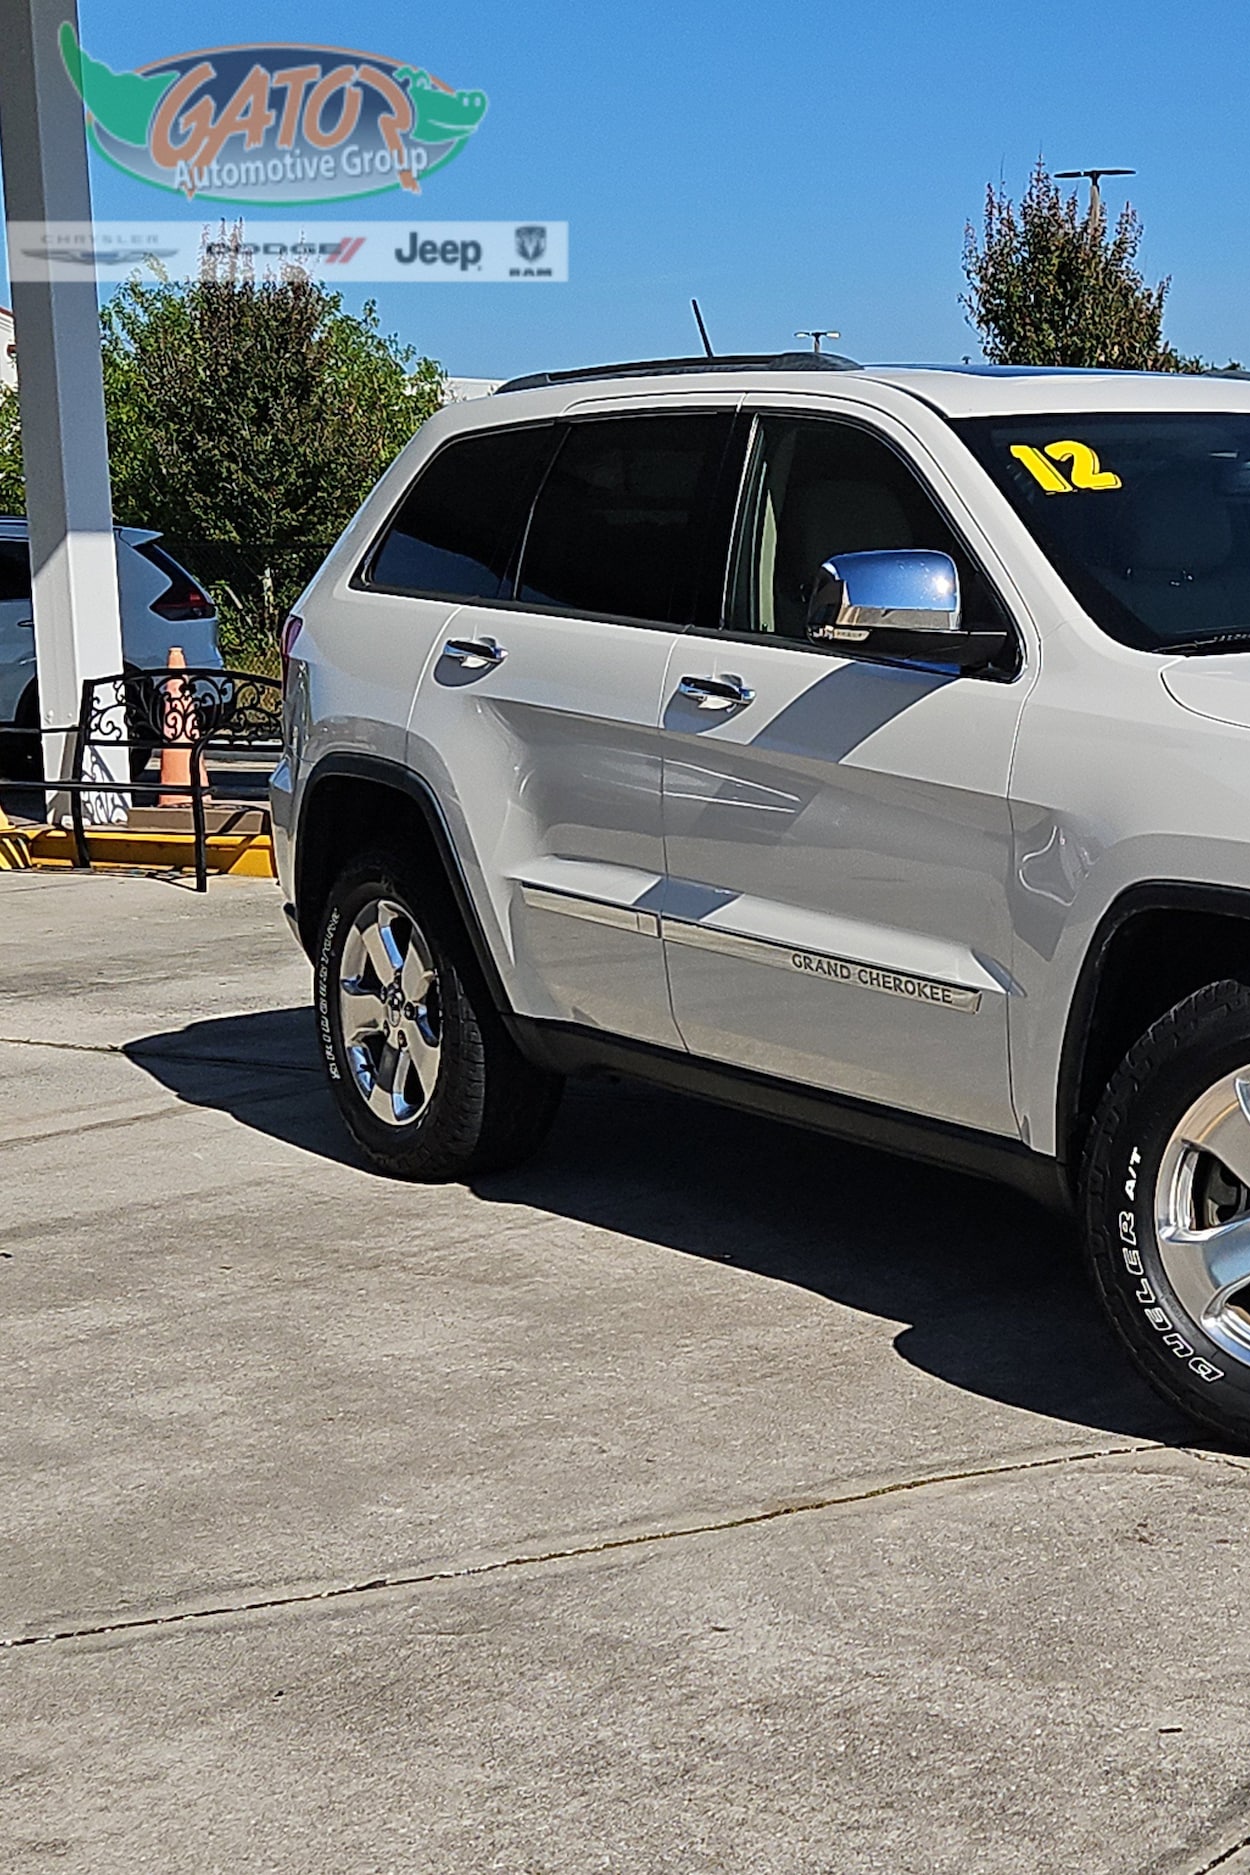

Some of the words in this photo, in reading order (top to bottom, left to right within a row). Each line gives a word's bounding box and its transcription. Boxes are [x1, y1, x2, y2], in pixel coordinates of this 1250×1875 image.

[1009, 440, 1122, 494] 12
[791, 953, 851, 979] GRAND
[857, 968, 954, 1004] CHEROKEE
[1122, 1145, 1143, 1203] A/T
[1118, 1210, 1225, 1383] DUELER
